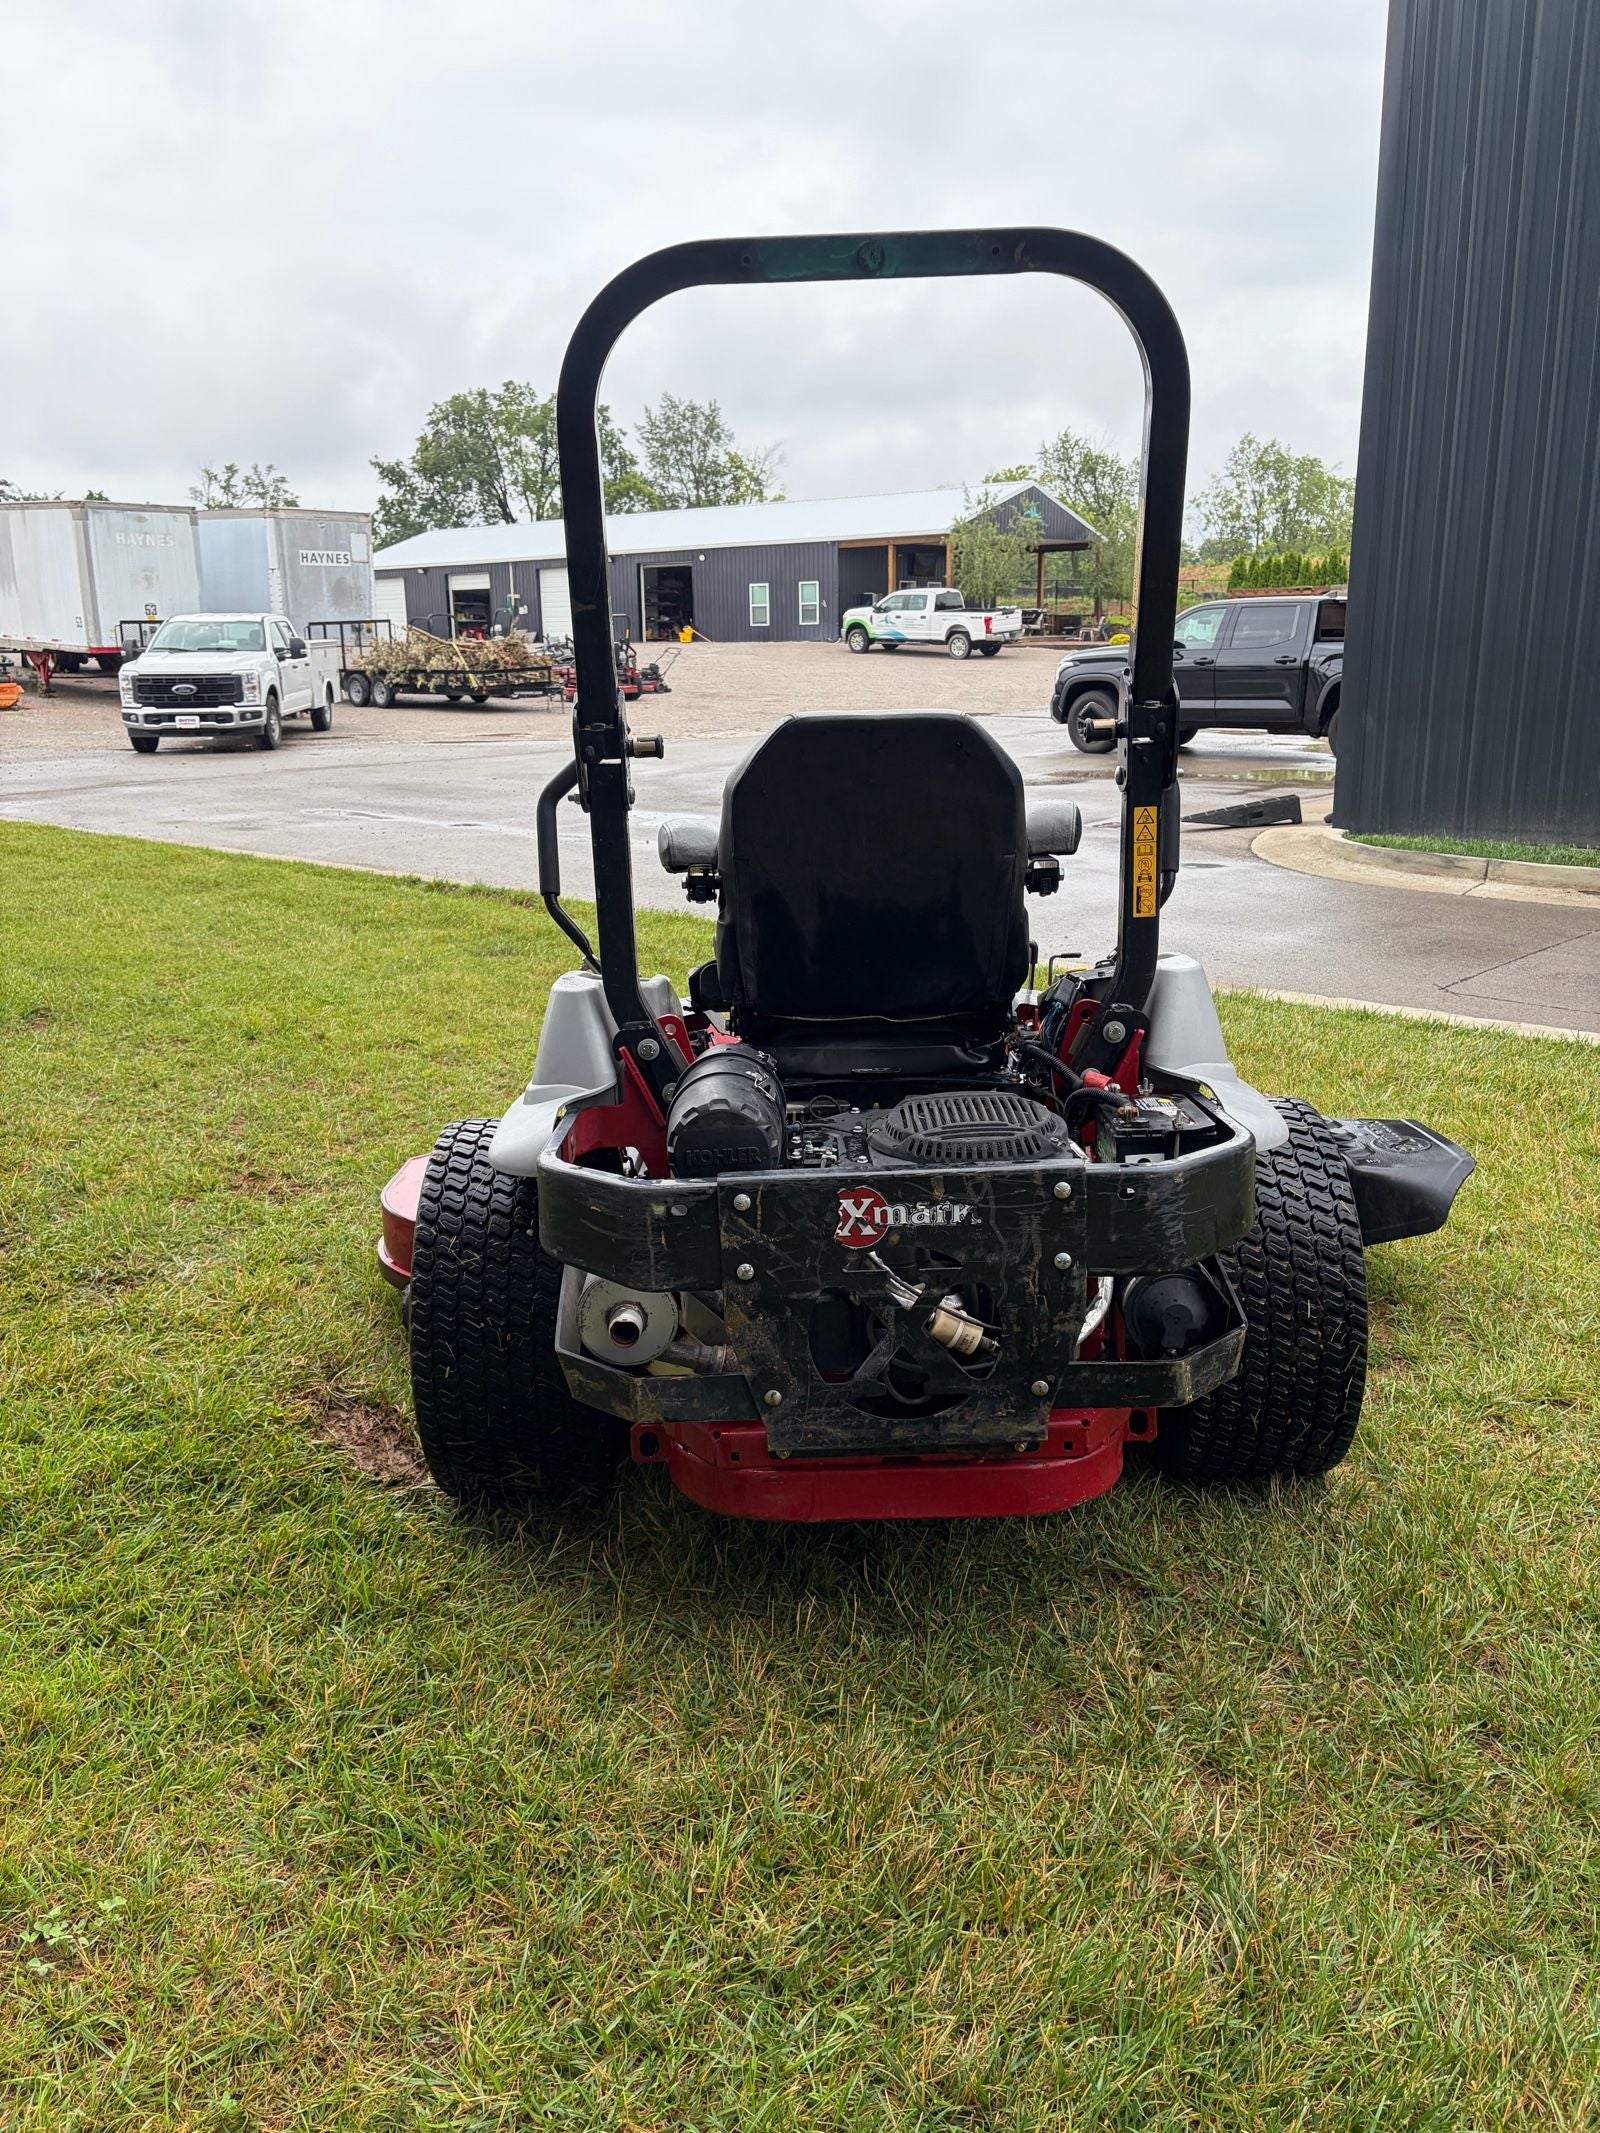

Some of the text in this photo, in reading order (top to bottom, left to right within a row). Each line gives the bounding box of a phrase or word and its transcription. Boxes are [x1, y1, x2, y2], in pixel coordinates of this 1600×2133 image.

[115, 532, 175, 547] HAYNES
[300, 552, 350, 565] HAYNES
[145, 603, 157, 616] 53
[685, 1146, 761, 1167] KOHLER
